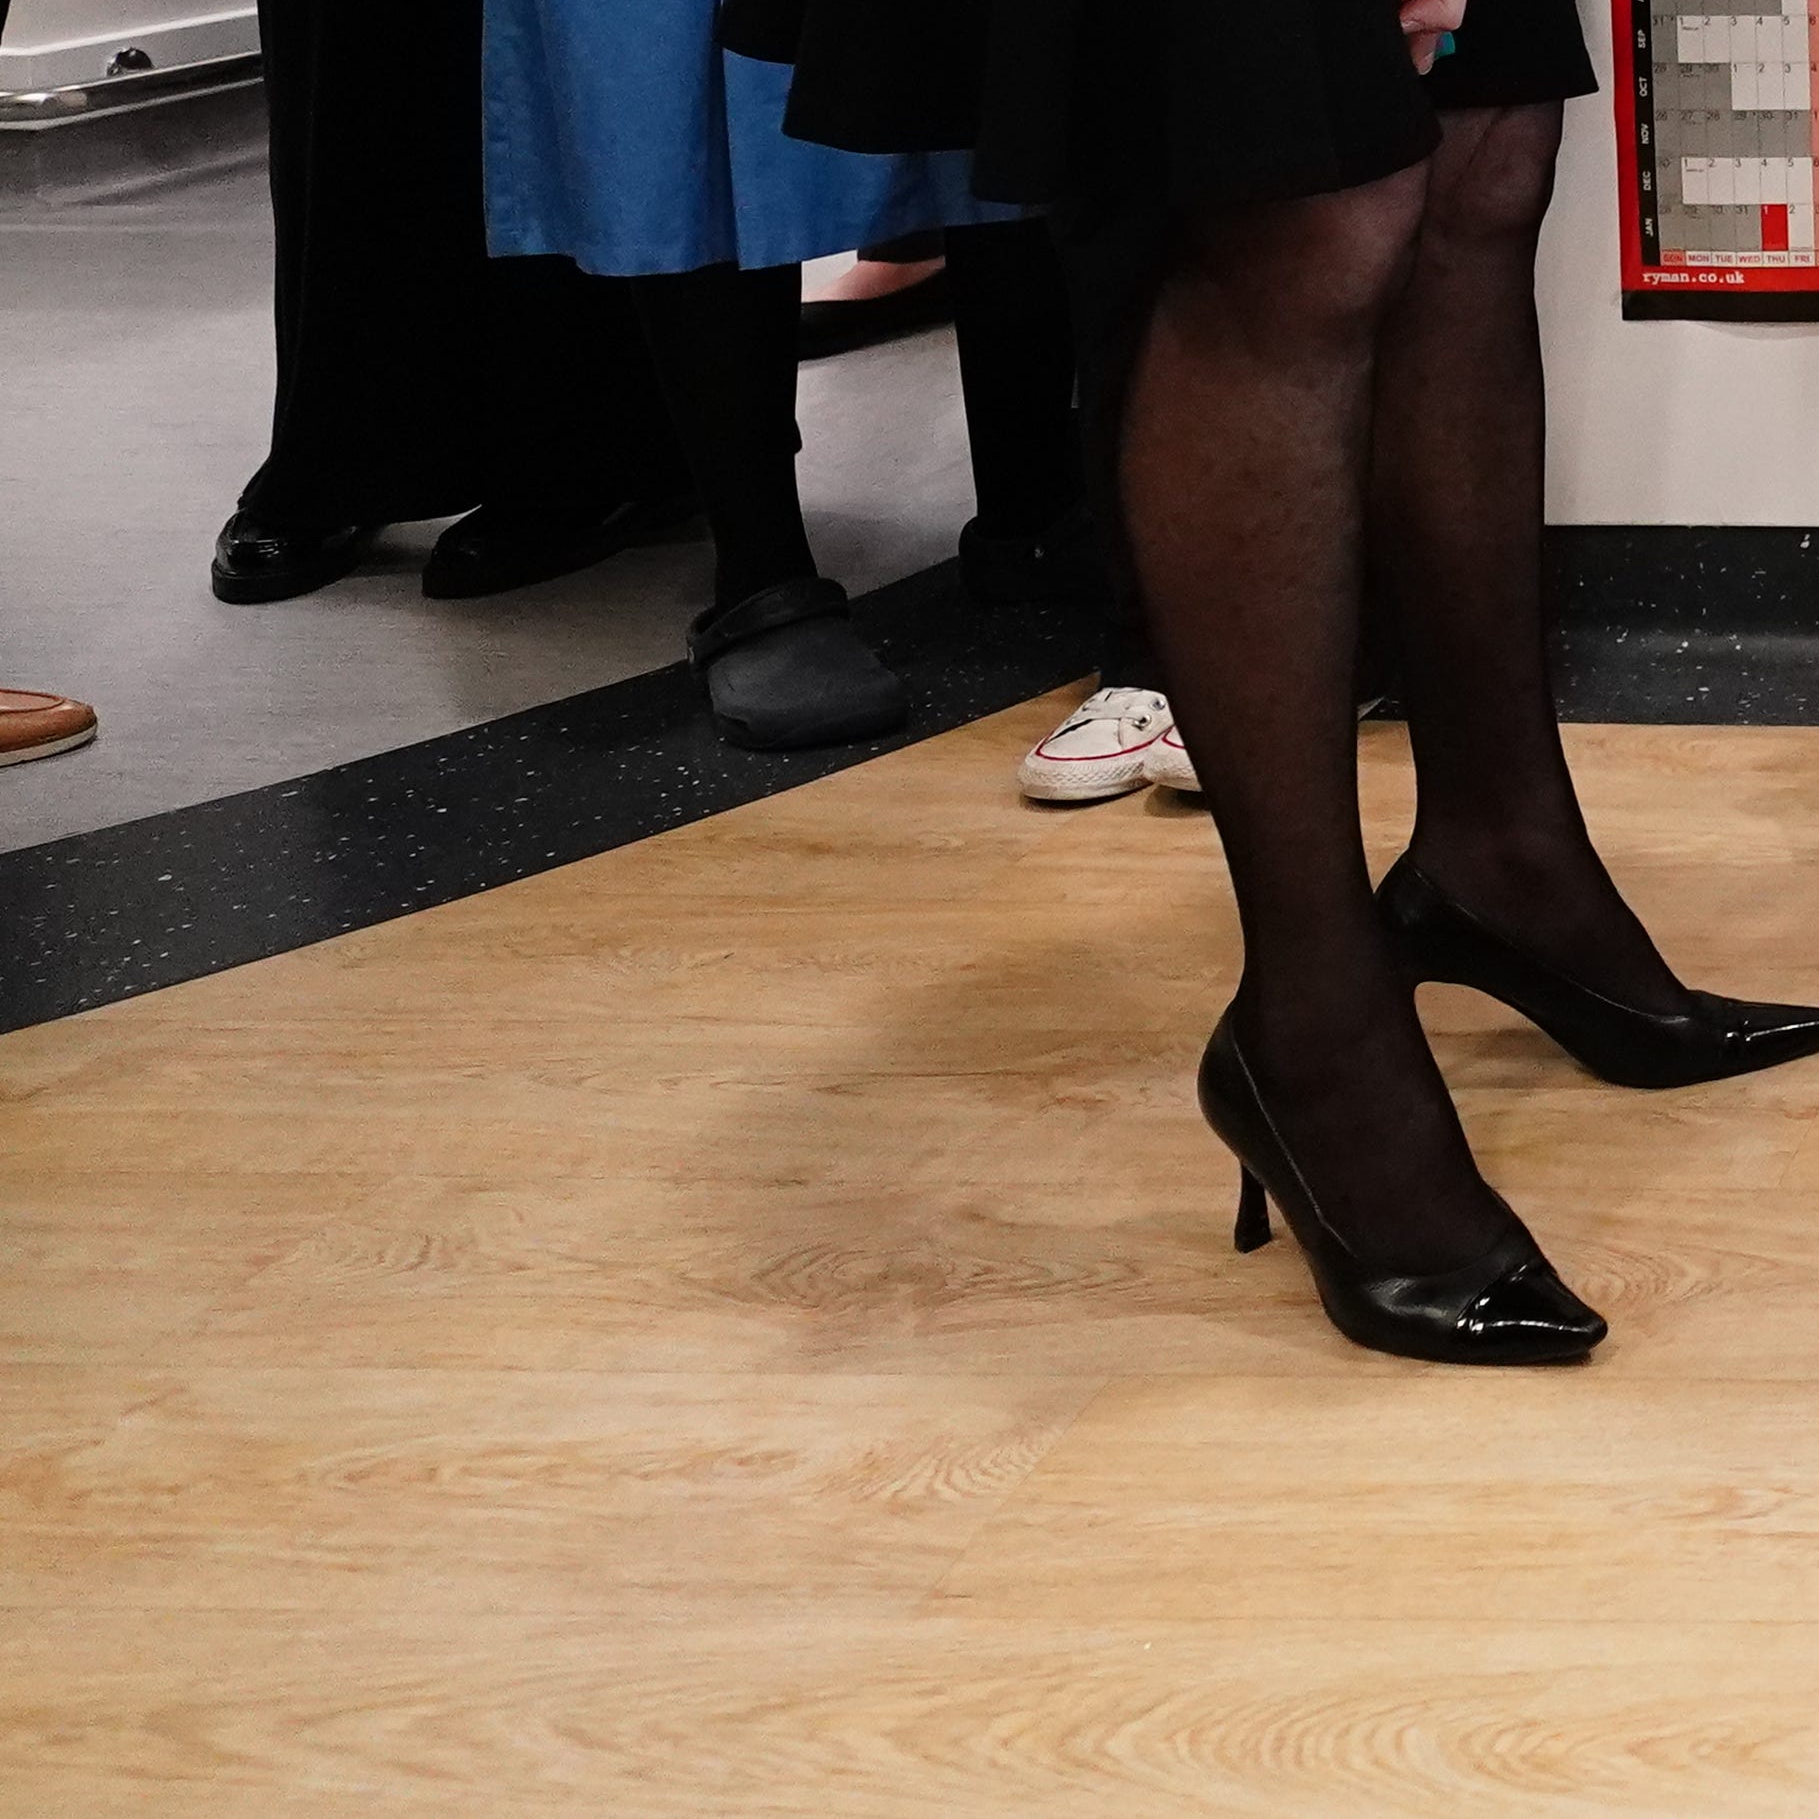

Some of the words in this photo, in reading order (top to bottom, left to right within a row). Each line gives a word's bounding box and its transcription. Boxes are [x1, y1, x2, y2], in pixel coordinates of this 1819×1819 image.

[1637, 29, 1647, 49] SEP
[1639, 75, 1648, 97] OCT
[1642, 171, 1652, 191] DEC
[1642, 270, 1745, 285] ryman.co.uk
